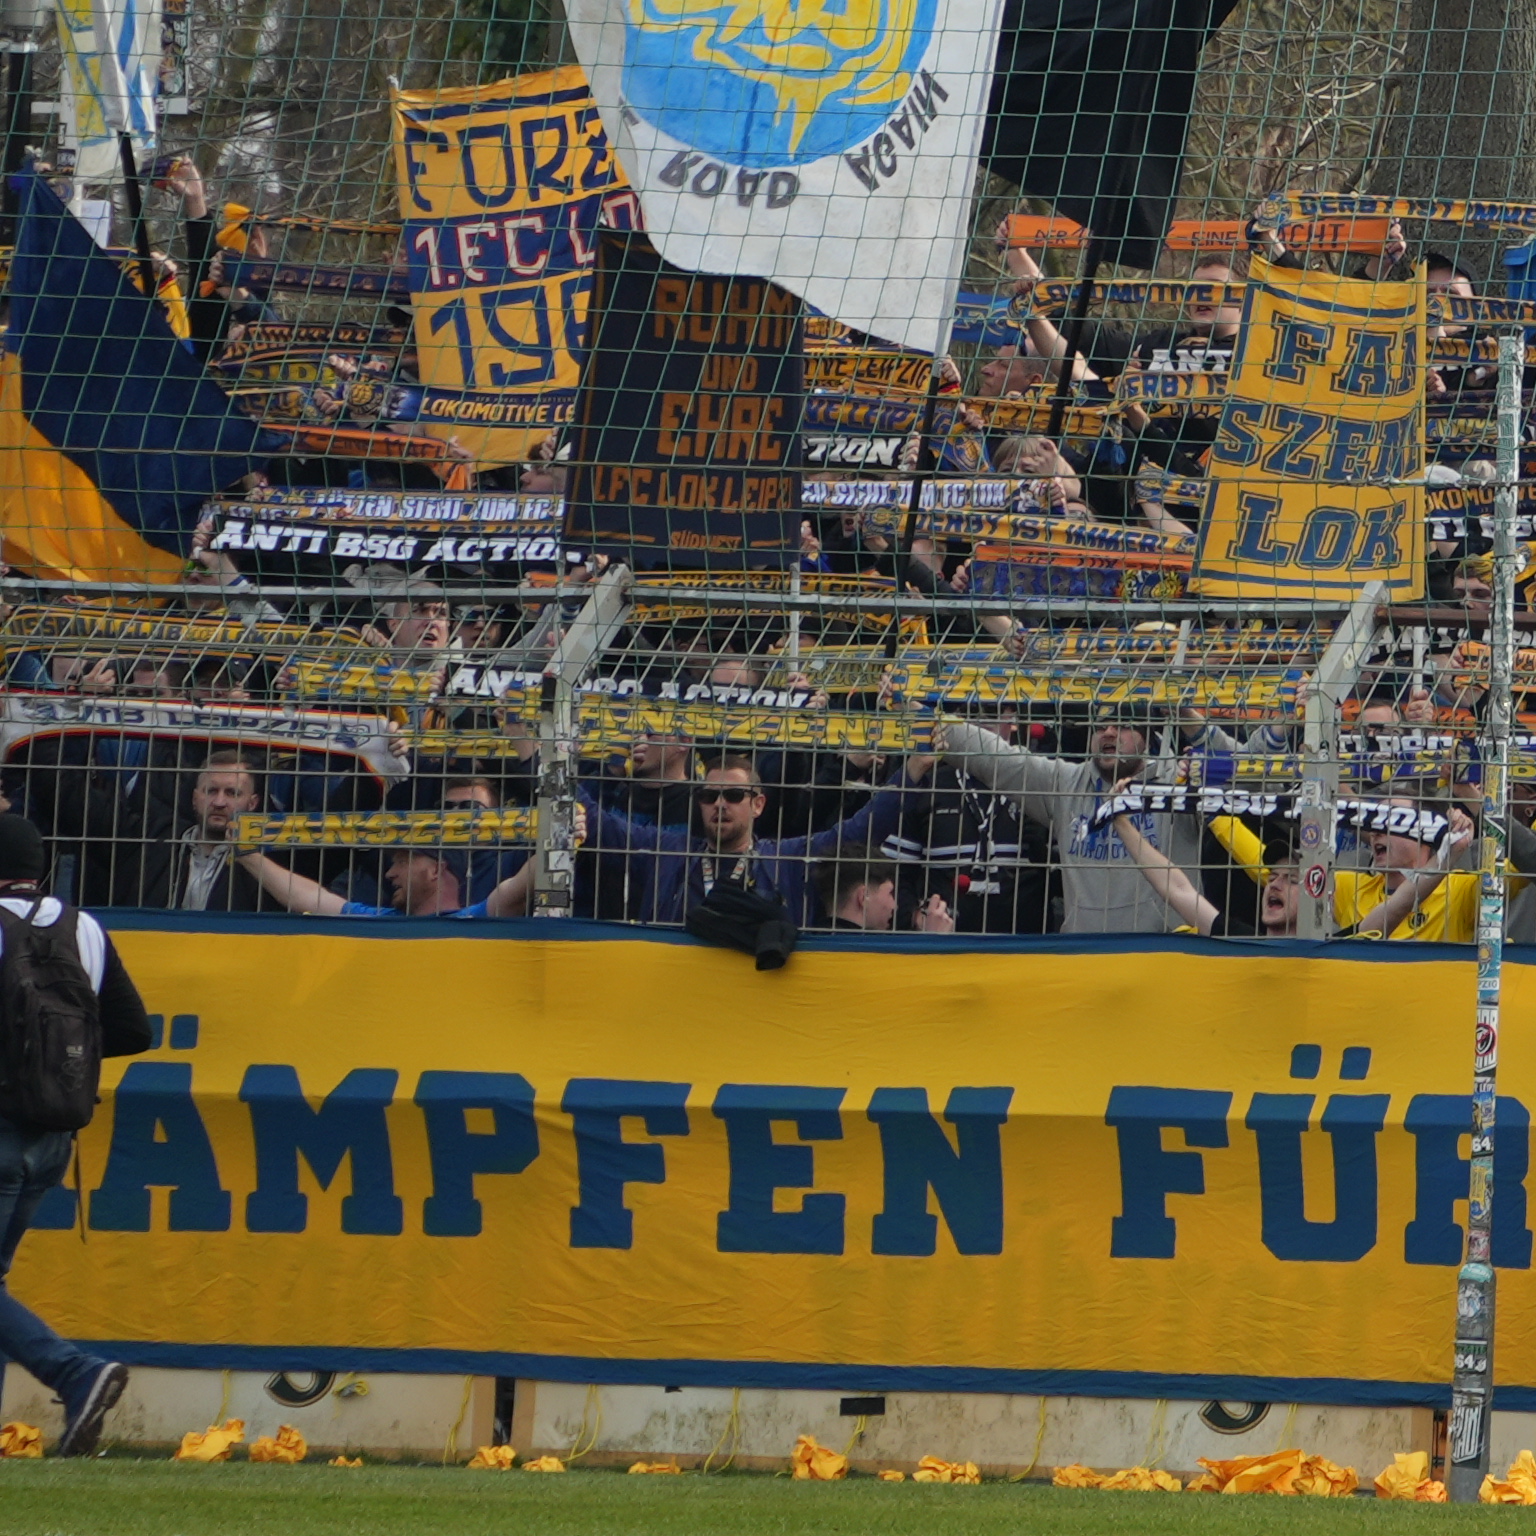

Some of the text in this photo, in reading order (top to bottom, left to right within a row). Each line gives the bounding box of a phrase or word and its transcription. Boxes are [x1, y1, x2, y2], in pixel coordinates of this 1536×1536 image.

[405, 102, 618, 211] FORZ
[1299, 193, 1396, 219] DERBY
[1407, 196, 1455, 221] IST
[1190, 229, 1239, 247] EINE
[1275, 221, 1346, 250] ACHT
[654, 278, 794, 348] RUHM
[702, 355, 758, 391] UND
[857, 357, 931, 388] LEIPZIG
[1148, 349, 1232, 372] ANT
[1123, 372, 1190, 398] ERBY
[419, 395, 548, 424] LOKOMOTIVE
[656, 392, 783, 461] EHRE
[807, 436, 901, 465] TION
[1210, 402, 1420, 483] SZEN
[656, 472, 794, 513] LOK LEIPZI
[211, 521, 582, 563] ANTI BSG ACTIO
[1009, 515, 1060, 544] IST
[1226, 491, 1406, 571] LOK
[1105, 1043, 1533, 1269] FÜR
